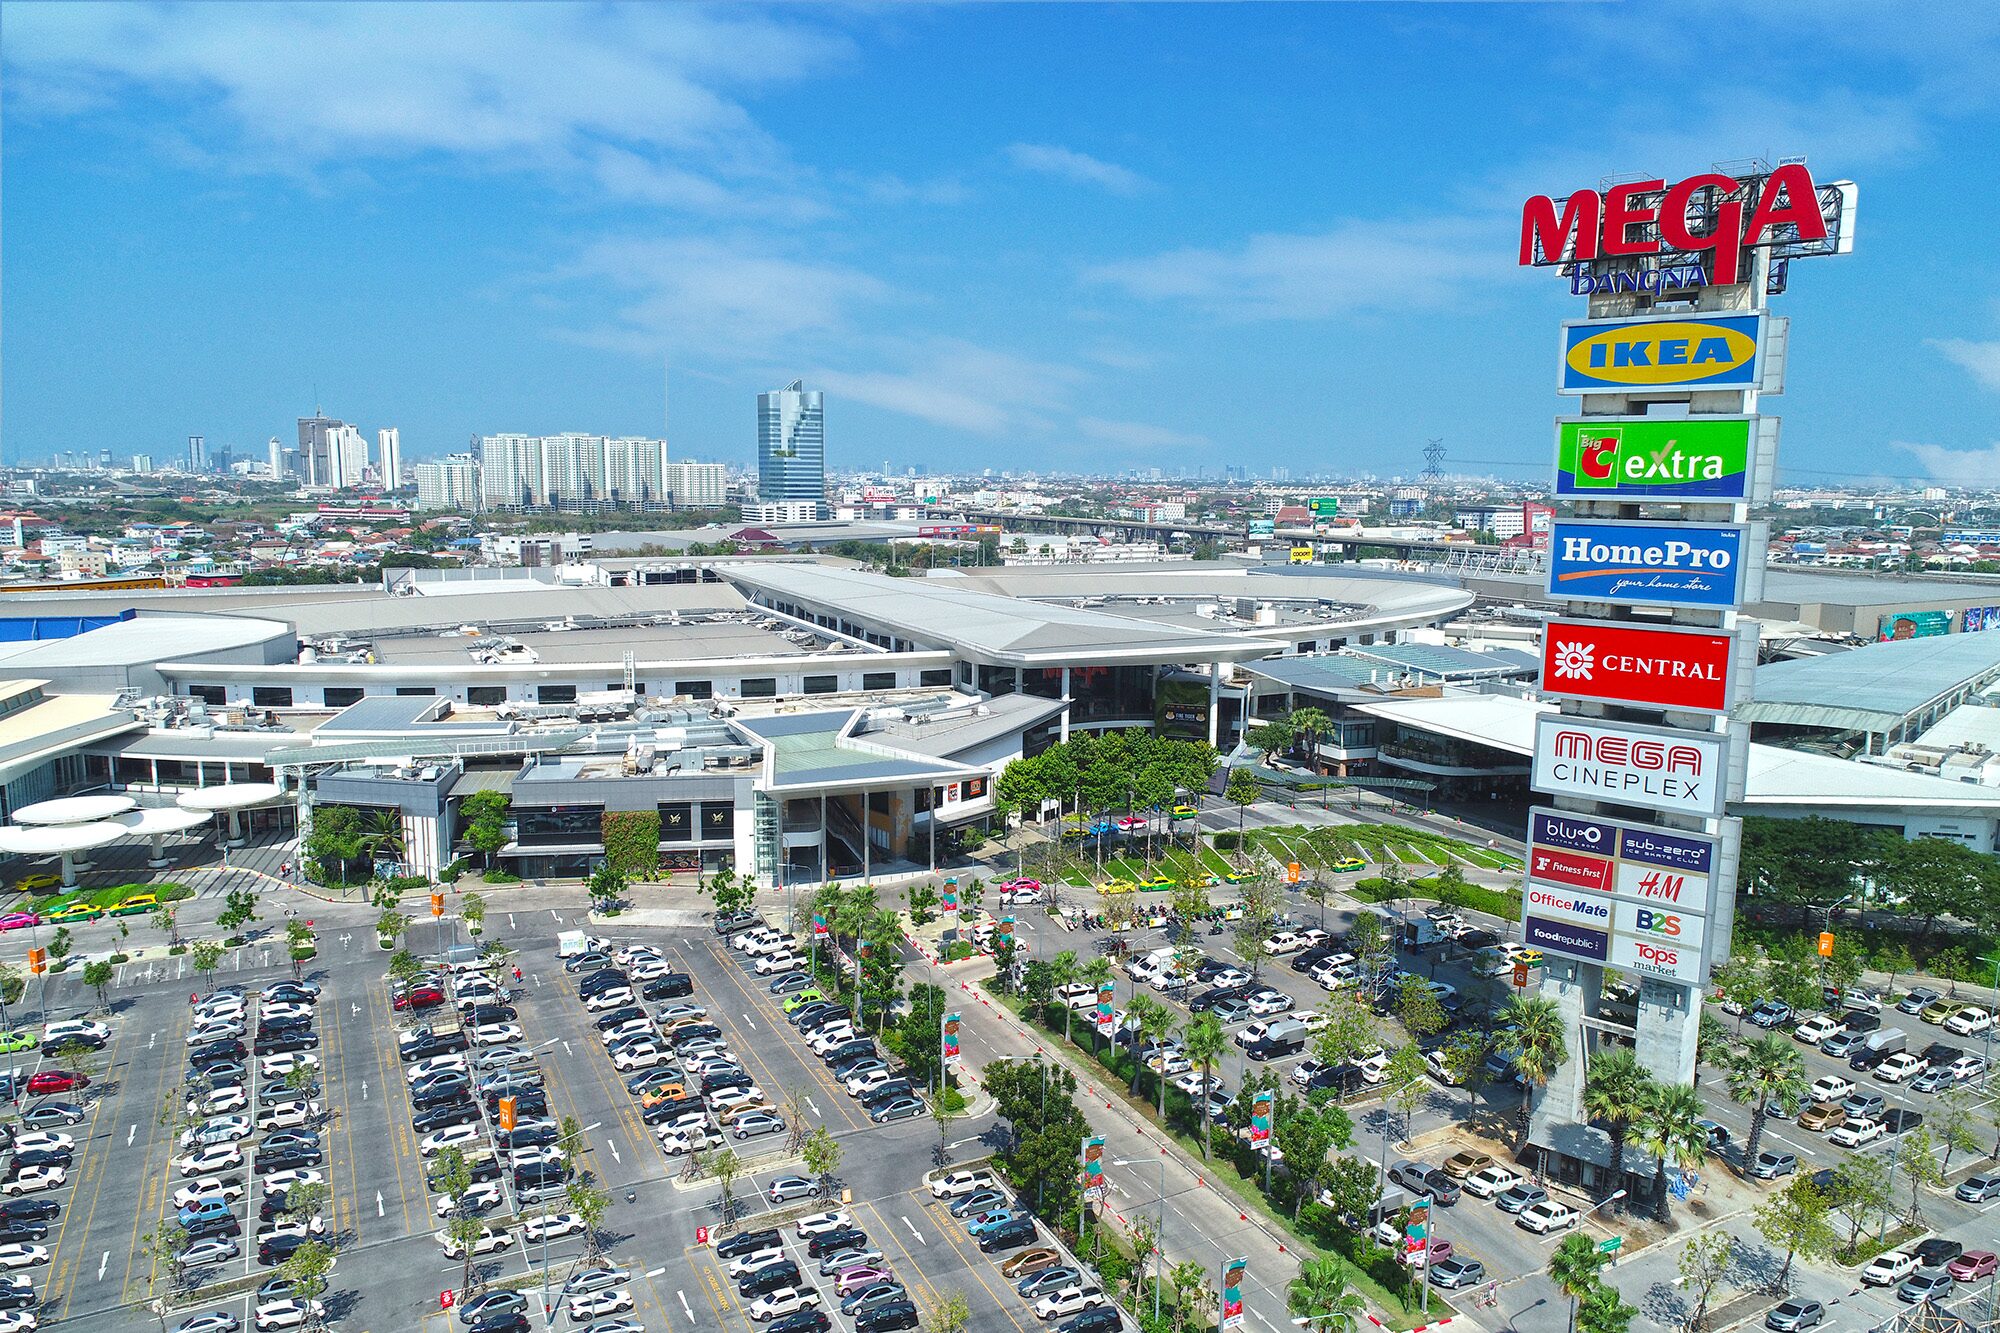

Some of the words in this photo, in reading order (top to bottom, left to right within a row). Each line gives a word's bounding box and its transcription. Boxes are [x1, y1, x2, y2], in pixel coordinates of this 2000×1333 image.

[1519, 164, 1829, 286] MEGA
[1589, 337, 1735, 369] IKEA
[1581, 437, 1602, 450] Big
[1561, 537, 1731, 569] HomePro
[1609, 578, 1645, 594] your
[1645, 575, 1680, 588] home
[1680, 577, 1712, 591] store
[1602, 655, 1721, 681] CENTRAL
[1554, 730, 1702, 776] MEGA
[1553, 763, 1701, 801] CINEPLEX
[1637, 871, 1685, 903] H&M
[1530, 891, 1608, 917] OfficeMate
[1636, 909, 1681, 936] B2S
[1635, 942, 1678, 965] Tops
[1633, 960, 1677, 977] market
